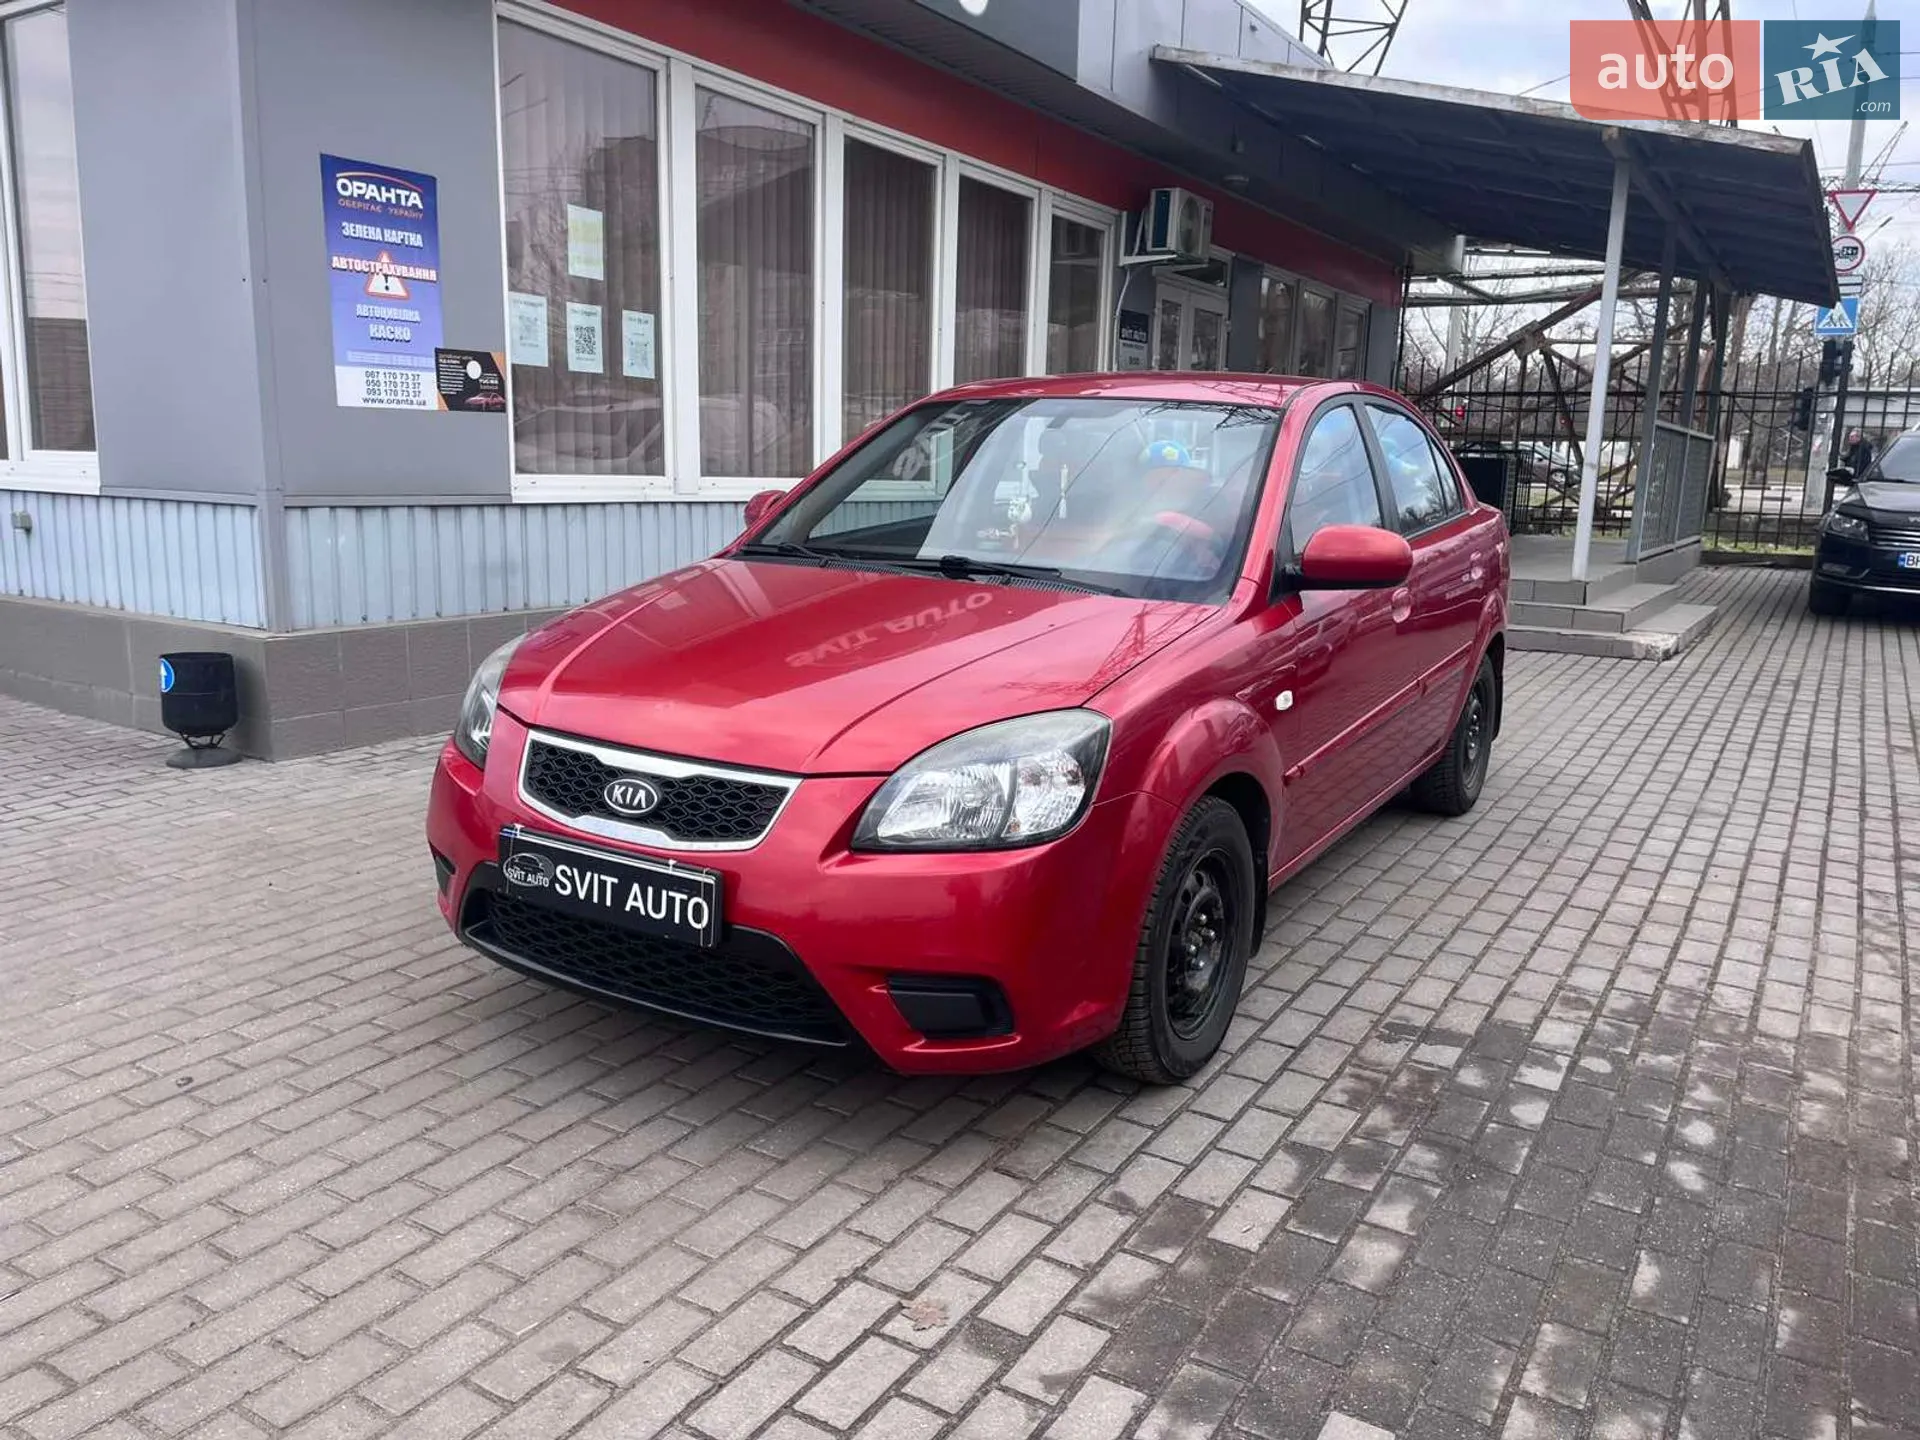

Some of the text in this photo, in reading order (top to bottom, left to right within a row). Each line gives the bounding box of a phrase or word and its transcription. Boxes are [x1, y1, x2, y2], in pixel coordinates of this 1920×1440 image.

[336, 178, 424, 209] ОРАНТА
[341, 221, 424, 248] ЗЕЛЕНА КАРТКА
[331, 255, 437, 282] АВТОСТРАХУВАННЯ
[356, 304, 420, 322] АВТОЦИВІЛКА
[369, 323, 412, 342] КАСКО
[383, 371, 398, 380] 170
[400, 372, 409, 380] 73
[411, 373, 421, 381] 37
[384, 380, 398, 388] 170
[400, 381, 409, 389] 73
[411, 382, 421, 390] 37
[361, 397, 426, 406] www.oranta.ua
[366, 388, 421, 398] 093 170 73 37
[611, 785, 646, 809] KIA
[507, 868, 549, 887] SVIT AUTO
[554, 864, 709, 930] SVIT AUTO
